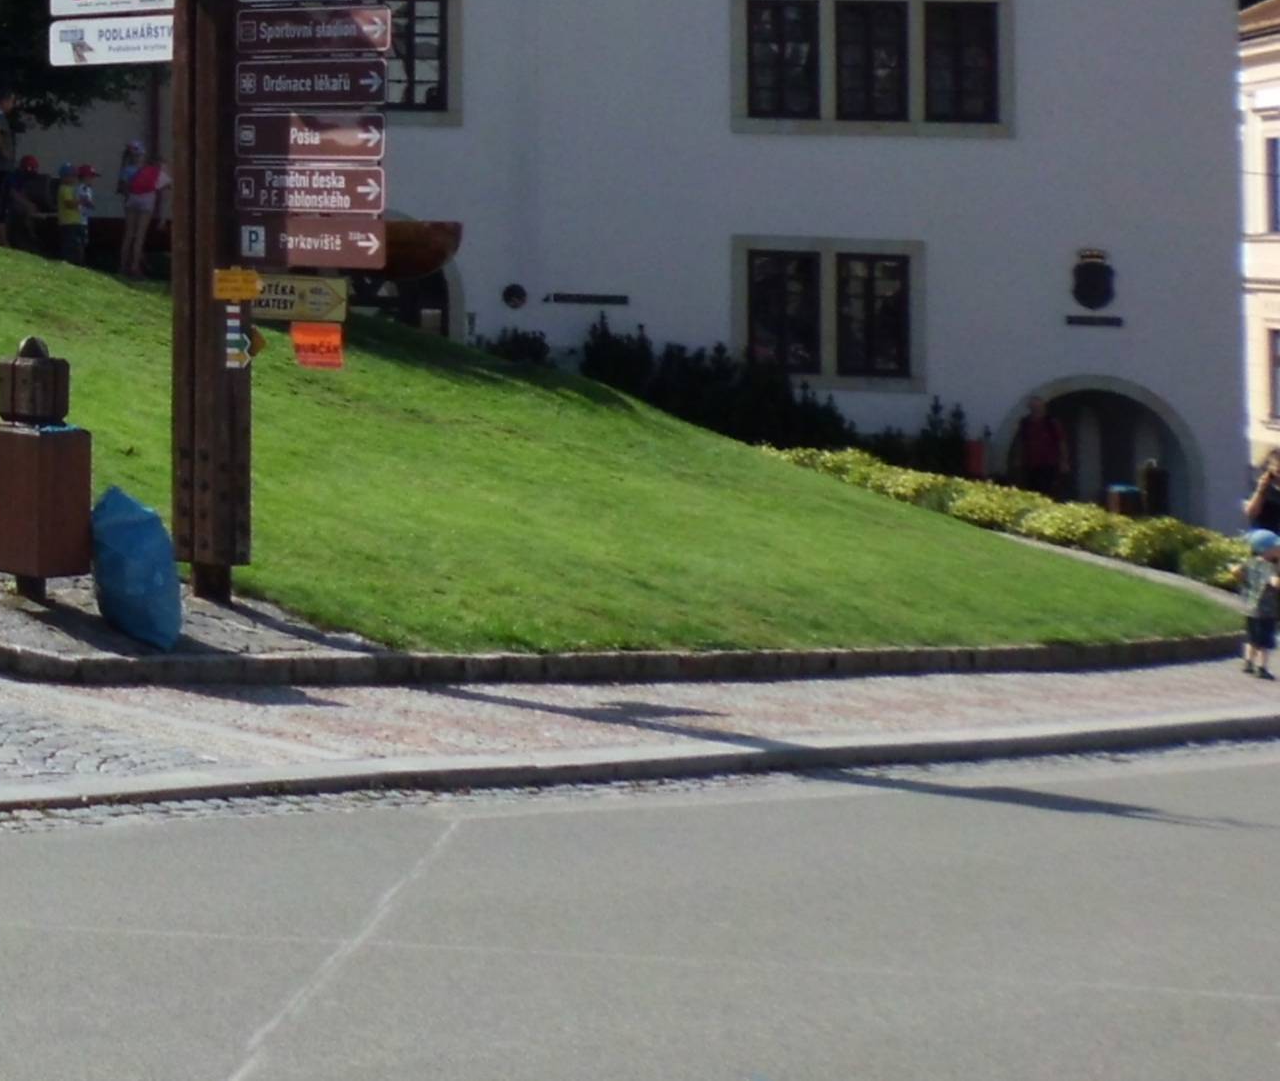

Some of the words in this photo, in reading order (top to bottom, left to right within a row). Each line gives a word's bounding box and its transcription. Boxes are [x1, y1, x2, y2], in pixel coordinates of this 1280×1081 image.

[98, 23, 174, 41] PODLAHÁŘSTV
[259, 21, 313, 43] Sportovní
[316, 22, 357, 39] stadion
[263, 74, 312, 92] Ordinace
[314, 72, 351, 92] lékařů
[290, 127, 321, 145] Pošta
[265, 170, 310, 188] Pamětní
[311, 171, 345, 189] deska
[282, 190, 351, 209] Jablonského
[248, 230, 259, 252] P
[279, 233, 342, 251] Parkoviště
